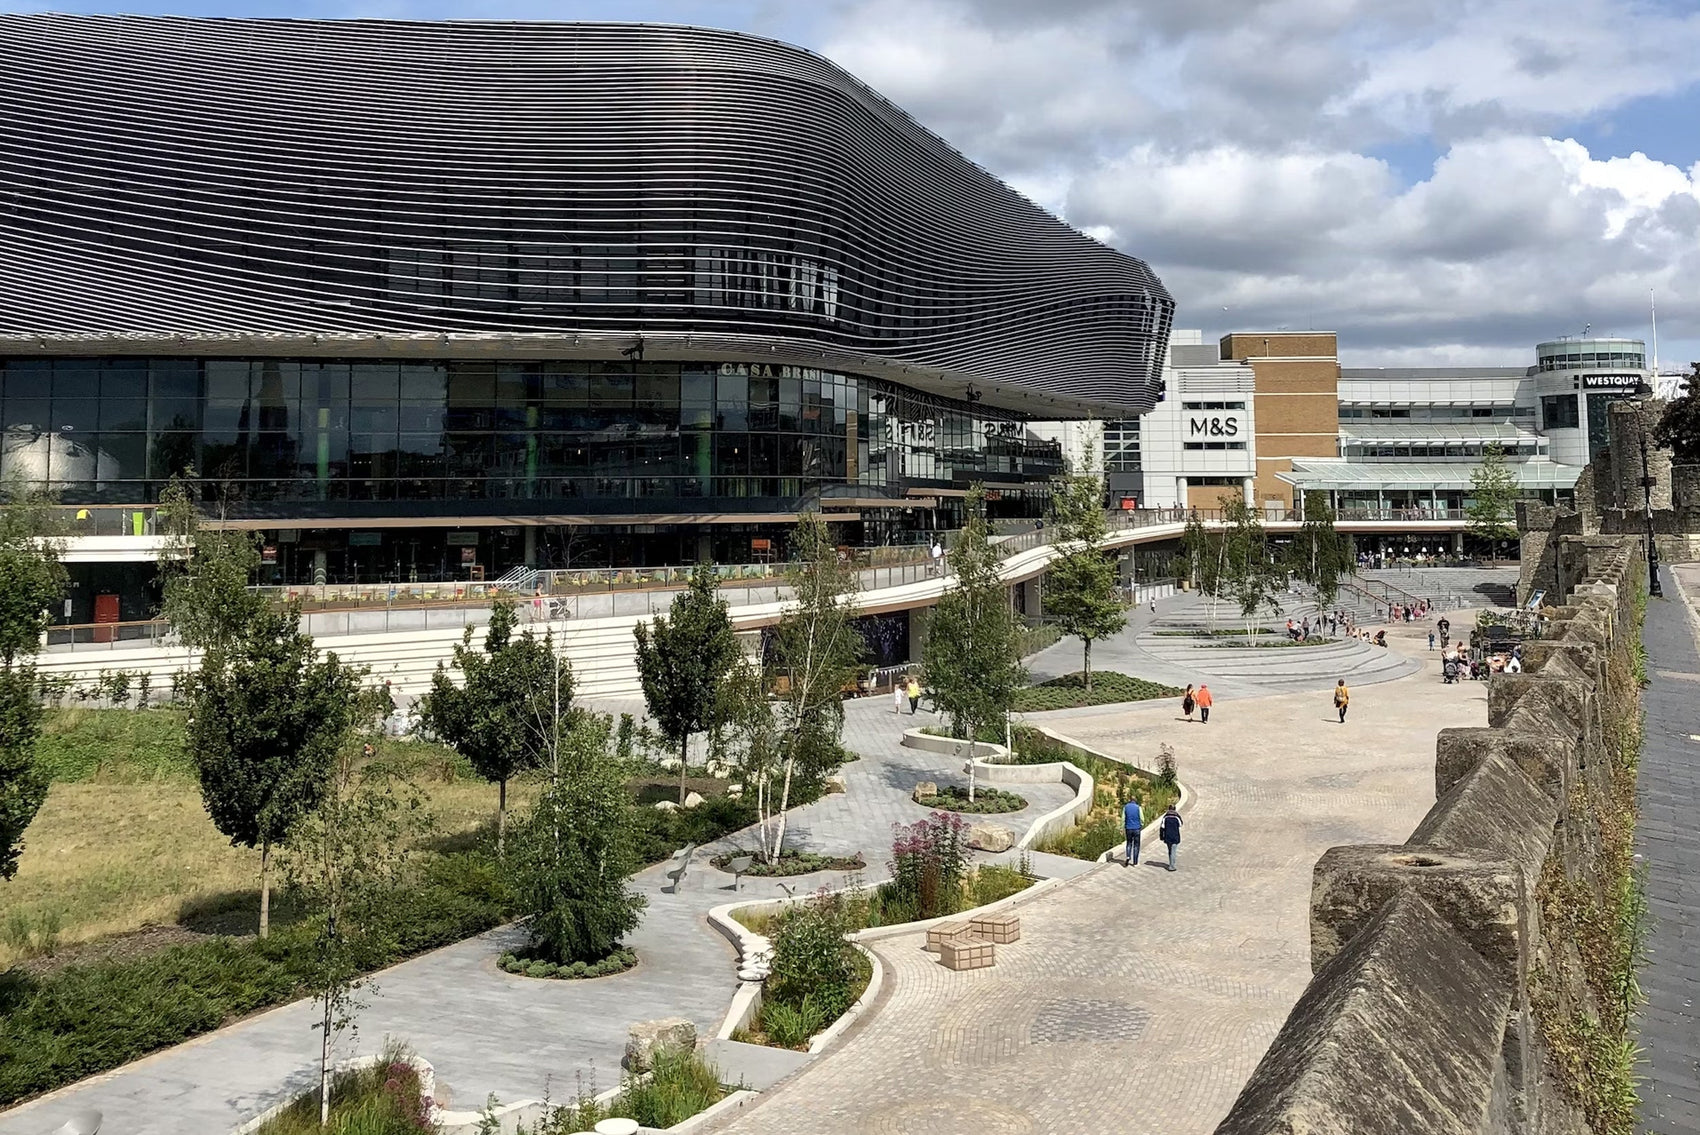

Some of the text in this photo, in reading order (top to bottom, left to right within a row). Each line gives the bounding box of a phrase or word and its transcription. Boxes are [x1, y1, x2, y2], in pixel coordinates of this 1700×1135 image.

[721, 363, 773, 377] CASA
[1586, 377, 1639, 385] WESTQUAY
[1191, 417, 1238, 437] M&S
